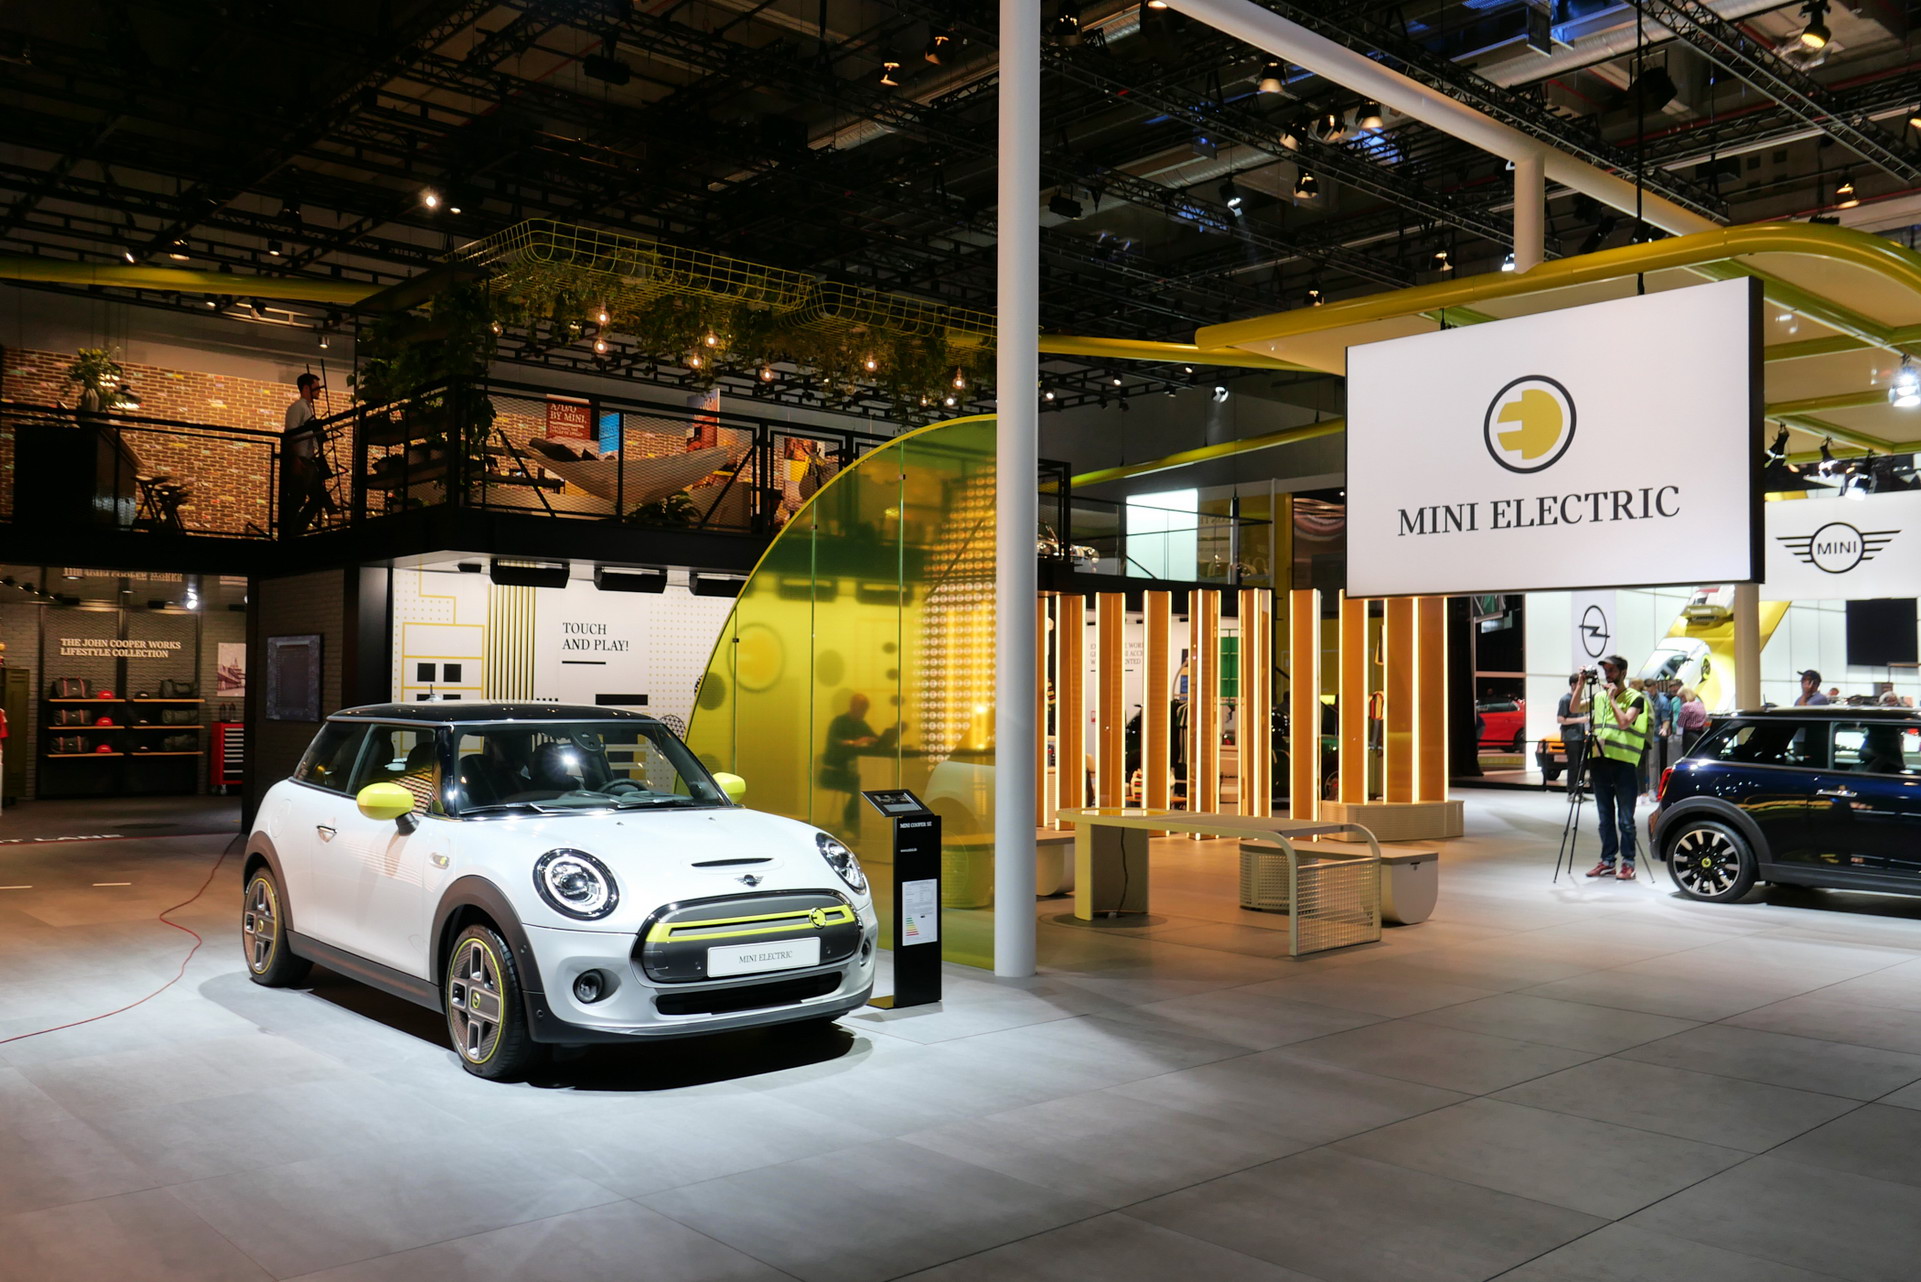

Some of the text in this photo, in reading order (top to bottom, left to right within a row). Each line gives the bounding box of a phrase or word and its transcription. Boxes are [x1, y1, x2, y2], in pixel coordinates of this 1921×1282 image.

[550, 411, 562, 420] BY
[1398, 485, 1681, 536] MINI ELECTRIC
[1817, 541, 1858, 555] MINI
[562, 622, 607, 635] TOUCH
[60, 638, 181, 650] THE JOHN COOPER WORKS
[562, 638, 629, 652] AND PLAY!
[60, 647, 169, 658] LIFESTYLE COLLECTION
[738, 950, 792, 964] MINI ELECTRIC
